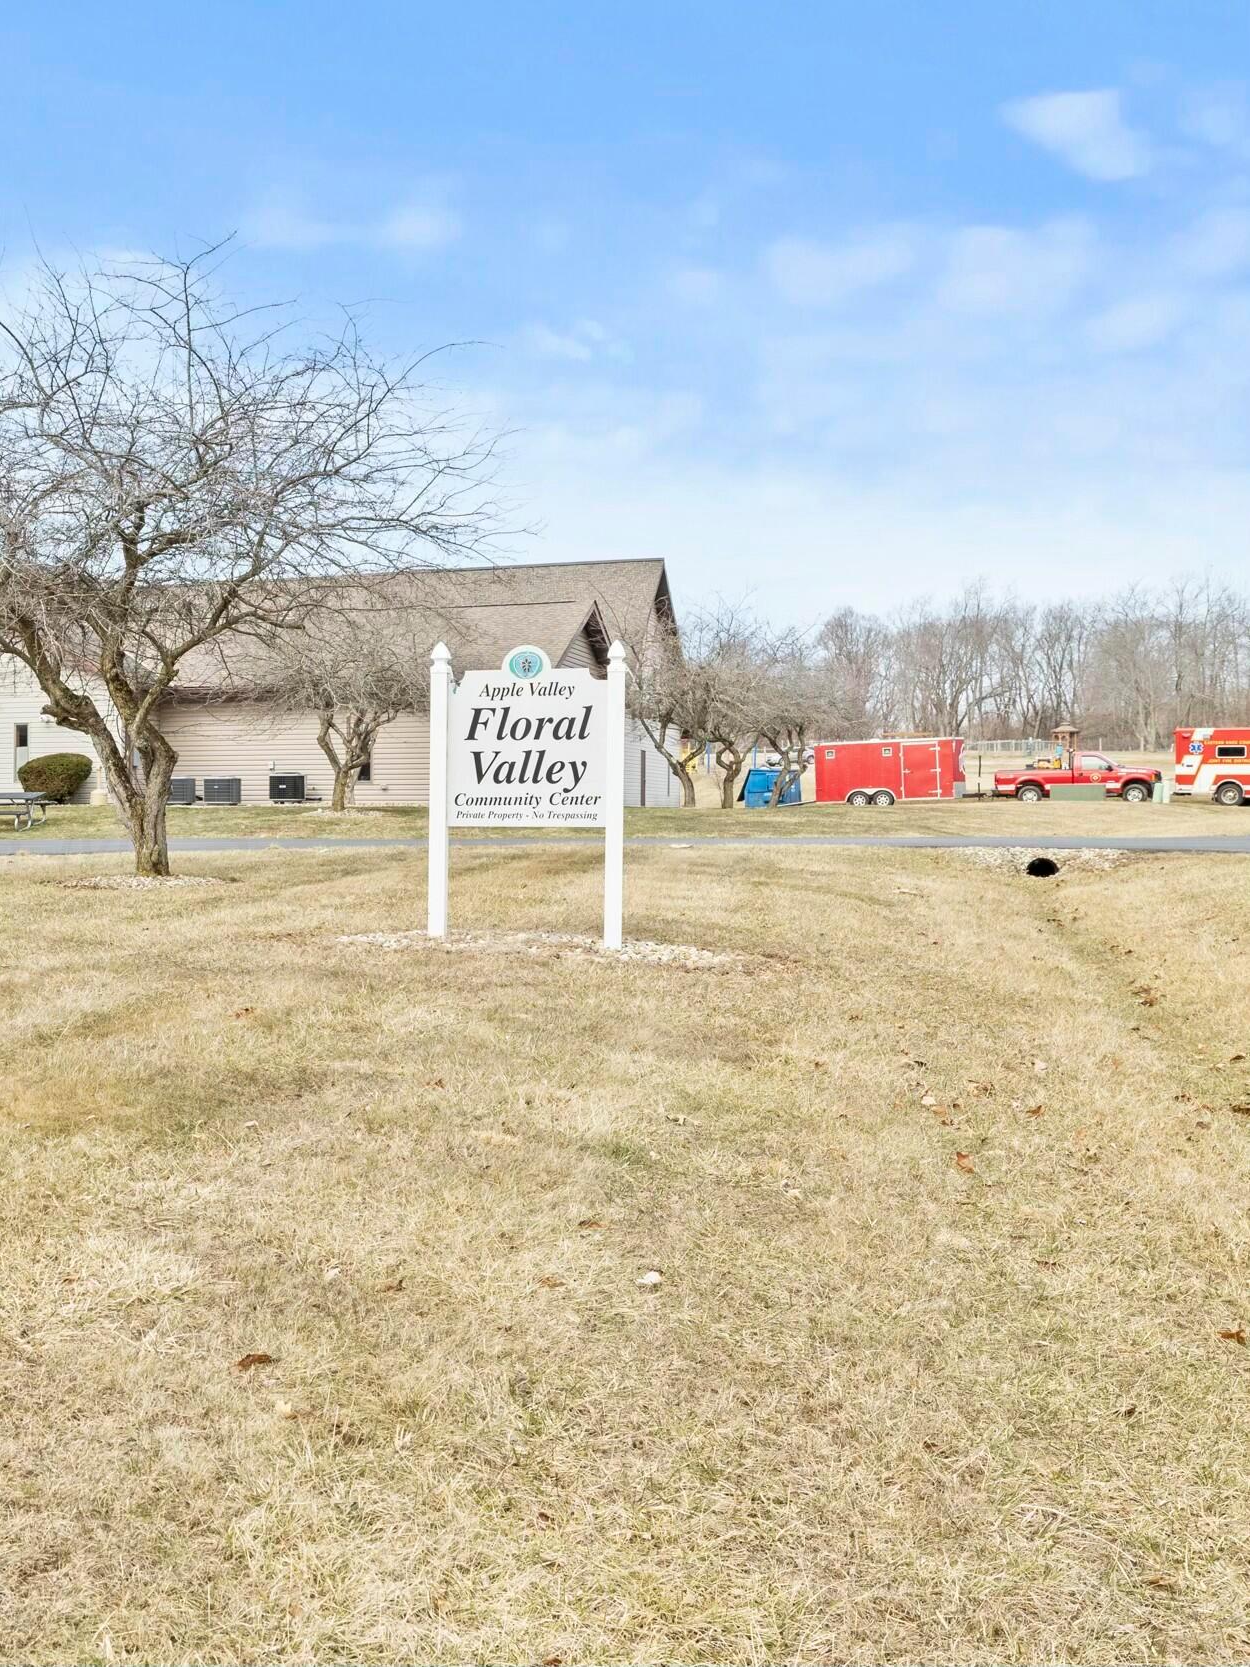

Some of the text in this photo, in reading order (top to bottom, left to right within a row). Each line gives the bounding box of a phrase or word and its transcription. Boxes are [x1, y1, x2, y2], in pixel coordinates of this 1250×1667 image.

[479, 681, 575, 701] Apple Valley
[464, 704, 593, 741] Floral
[470, 749, 588, 793] Valley
[454, 791, 602, 809] Community Center
[456, 810, 486, 820] Private
[488, 810, 524, 821] Property
[532, 810, 545, 819] No
[547, 810, 598, 821] Trespassing
